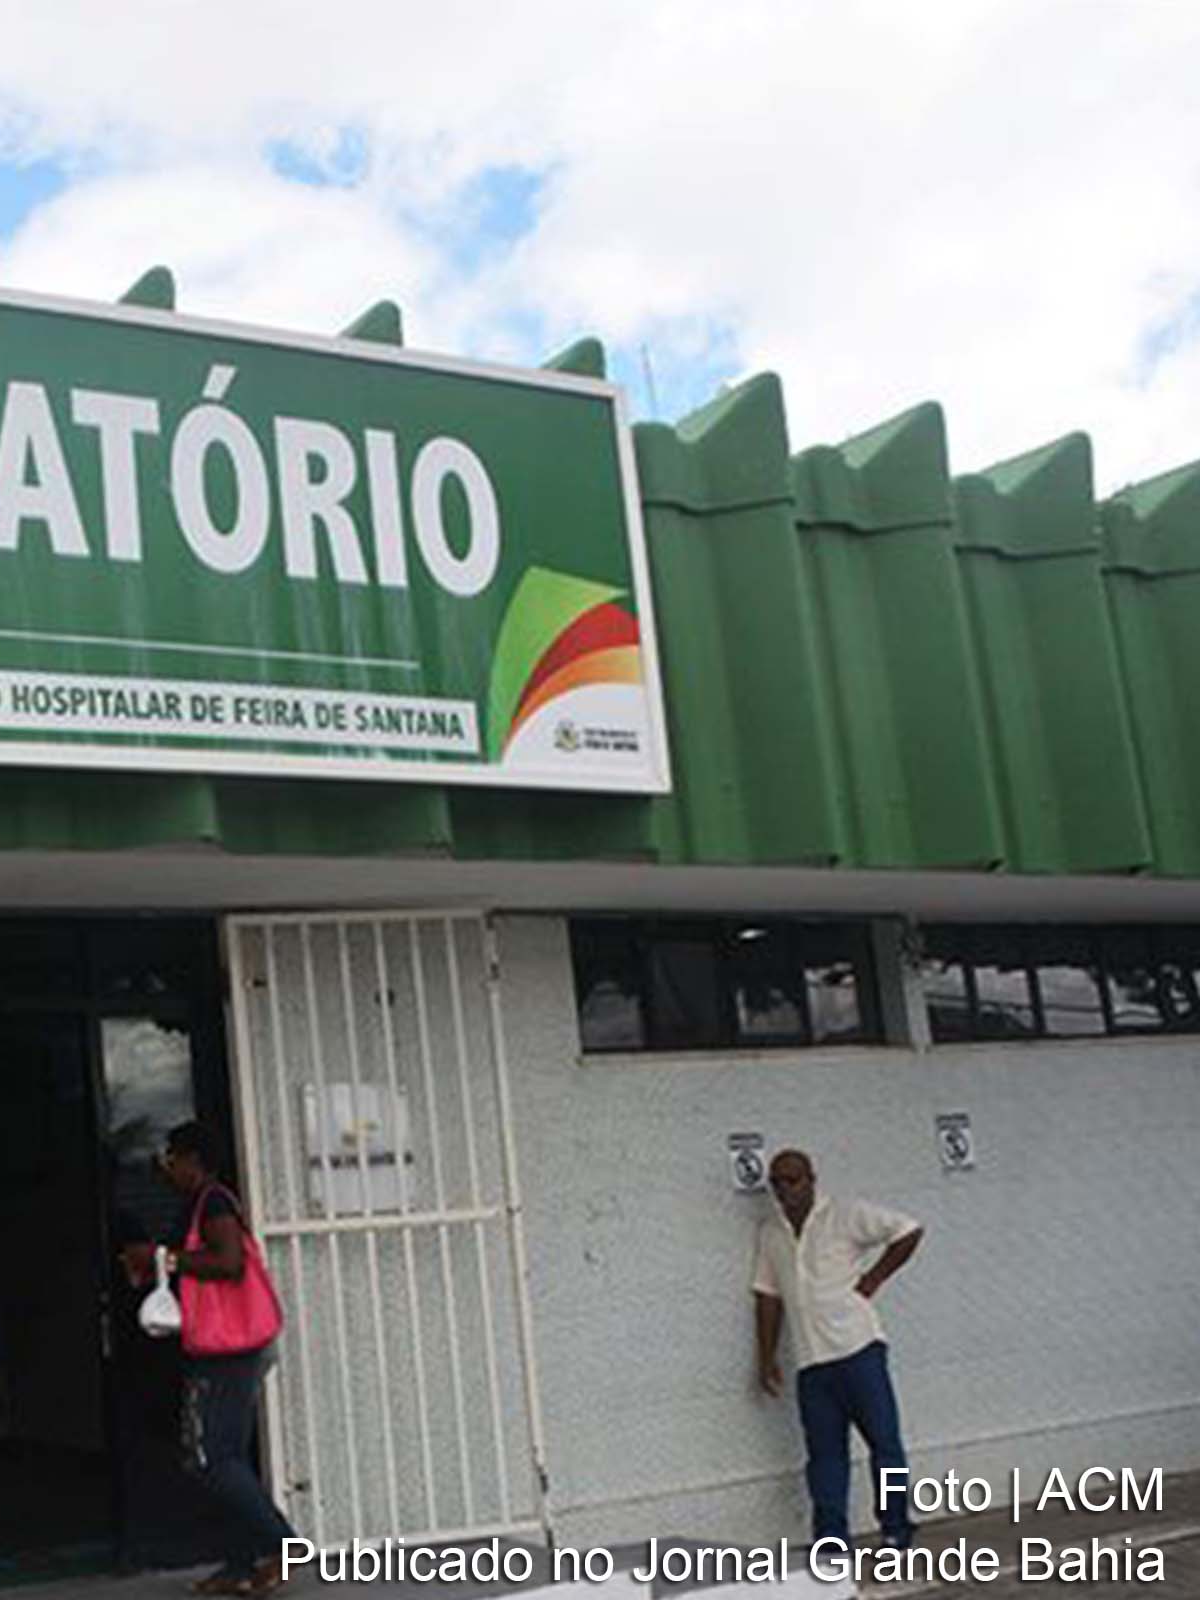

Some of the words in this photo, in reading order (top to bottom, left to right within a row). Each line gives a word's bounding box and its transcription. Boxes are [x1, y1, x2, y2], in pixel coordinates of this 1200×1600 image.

[11, 684, 183, 721] HOSPITALAR
[190, 696, 224, 724] DE
[234, 697, 308, 730] FEIRA
[315, 703, 348, 731] DE
[354, 705, 465, 740] SANTANA
